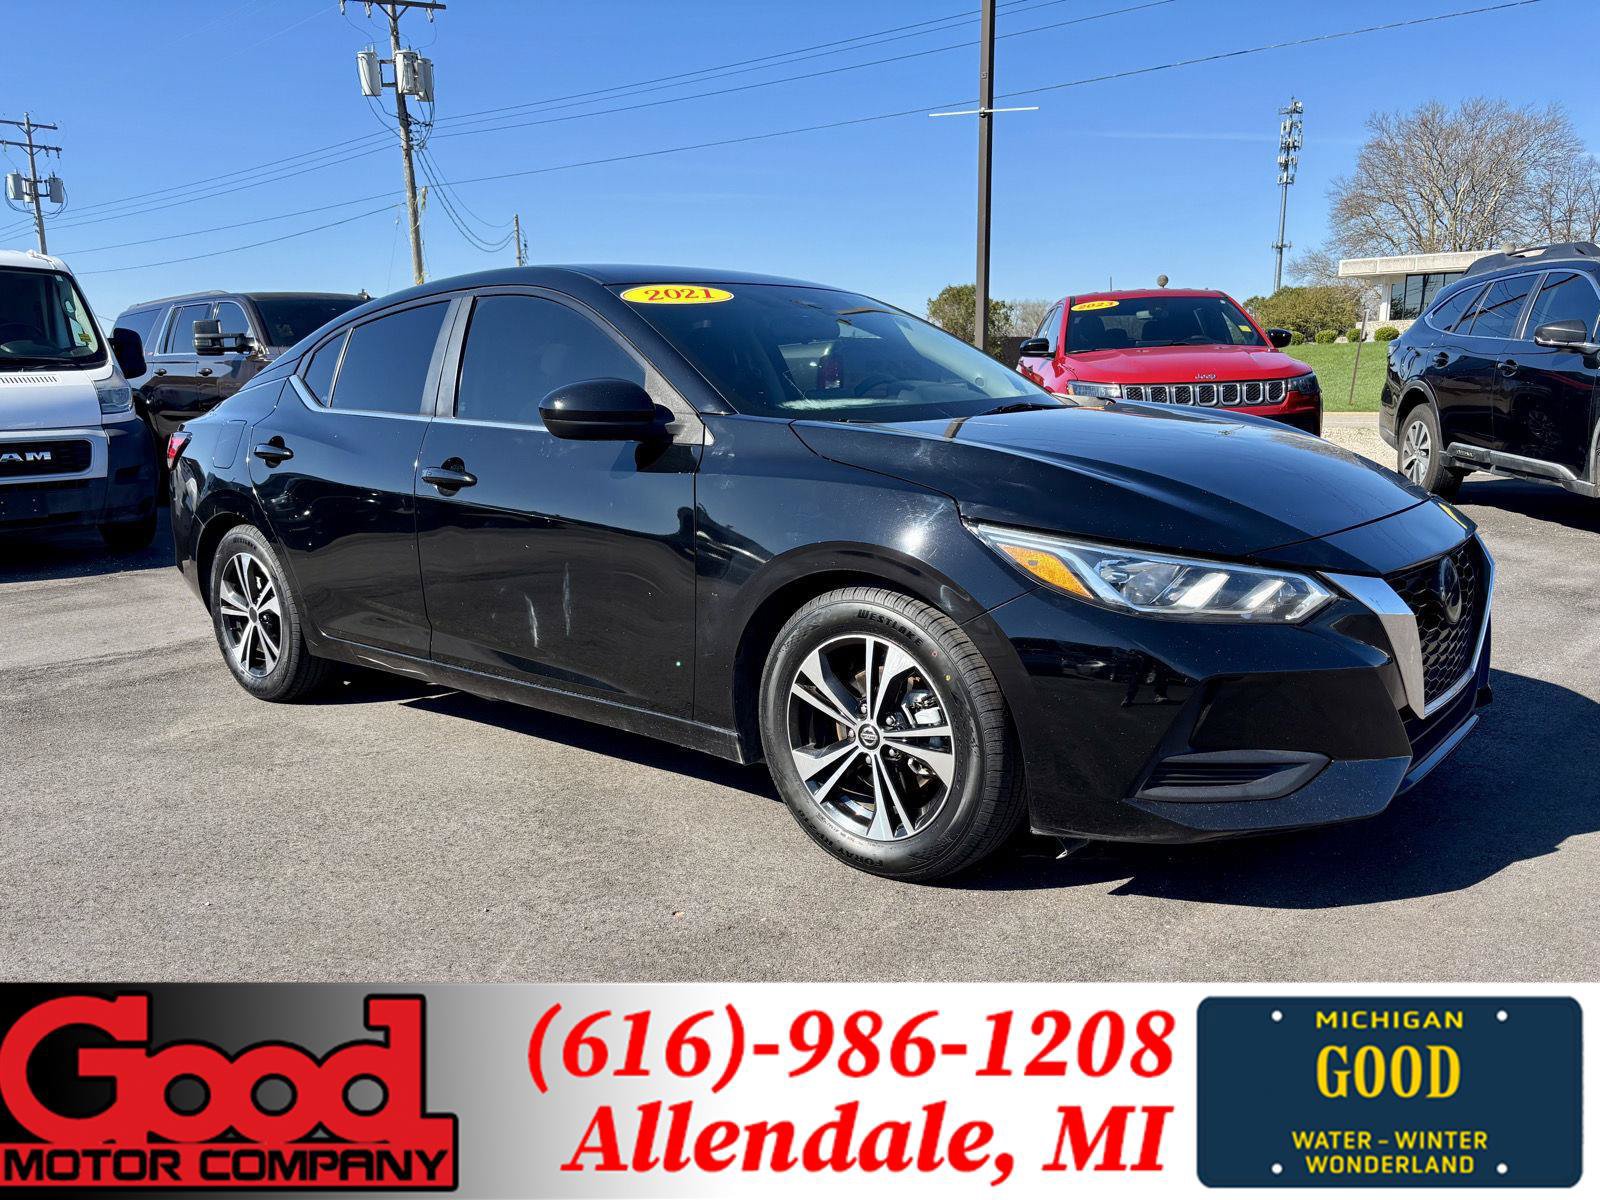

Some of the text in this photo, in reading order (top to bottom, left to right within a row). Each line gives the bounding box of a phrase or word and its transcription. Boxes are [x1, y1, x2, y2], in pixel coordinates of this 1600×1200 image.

[644, 288, 715, 301] 2021
[0, 451, 52, 462] AM
[857, 609, 924, 647] WESTLAKE
